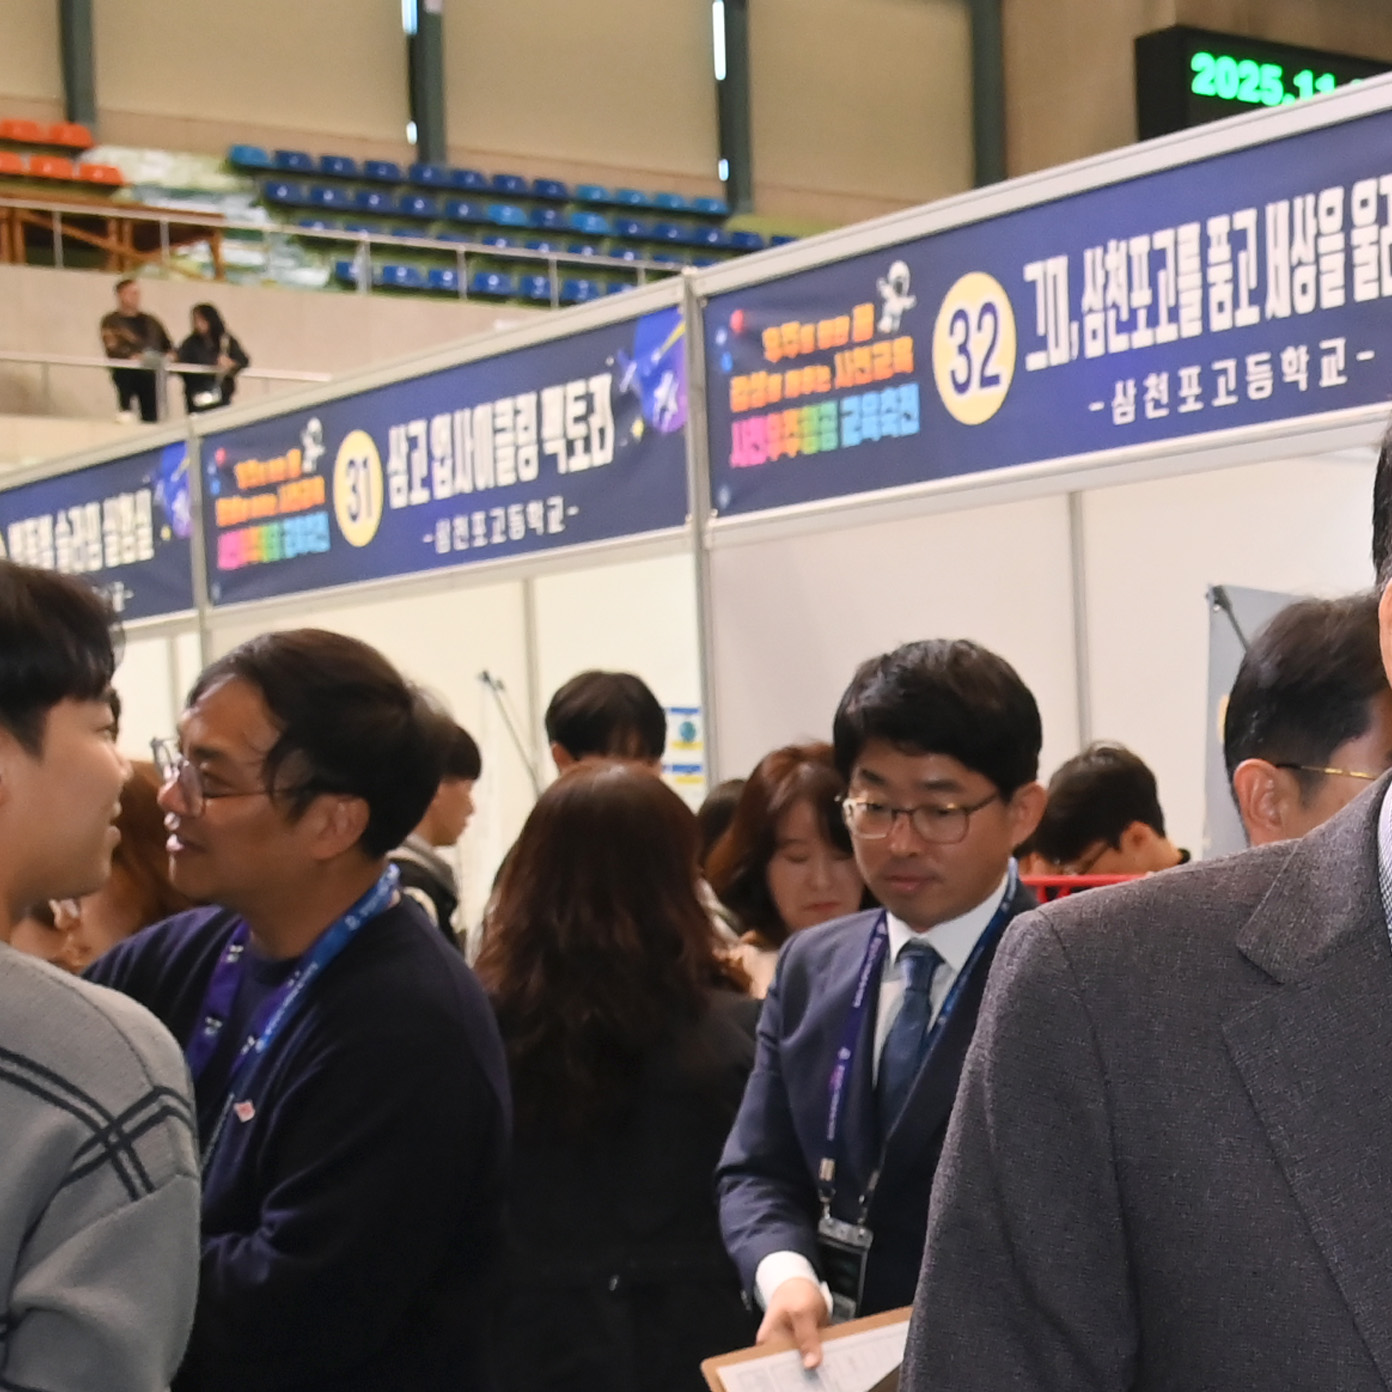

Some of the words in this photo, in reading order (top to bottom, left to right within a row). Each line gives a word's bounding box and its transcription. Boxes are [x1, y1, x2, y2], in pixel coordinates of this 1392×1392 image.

[1081, 221, 1202, 358] 삼천포고를
[1206, 207, 1260, 332] 품고
[1265, 185, 1345, 319] 세상을
[949, 302, 1001, 395] 32
[347, 456, 373, 522] 31
